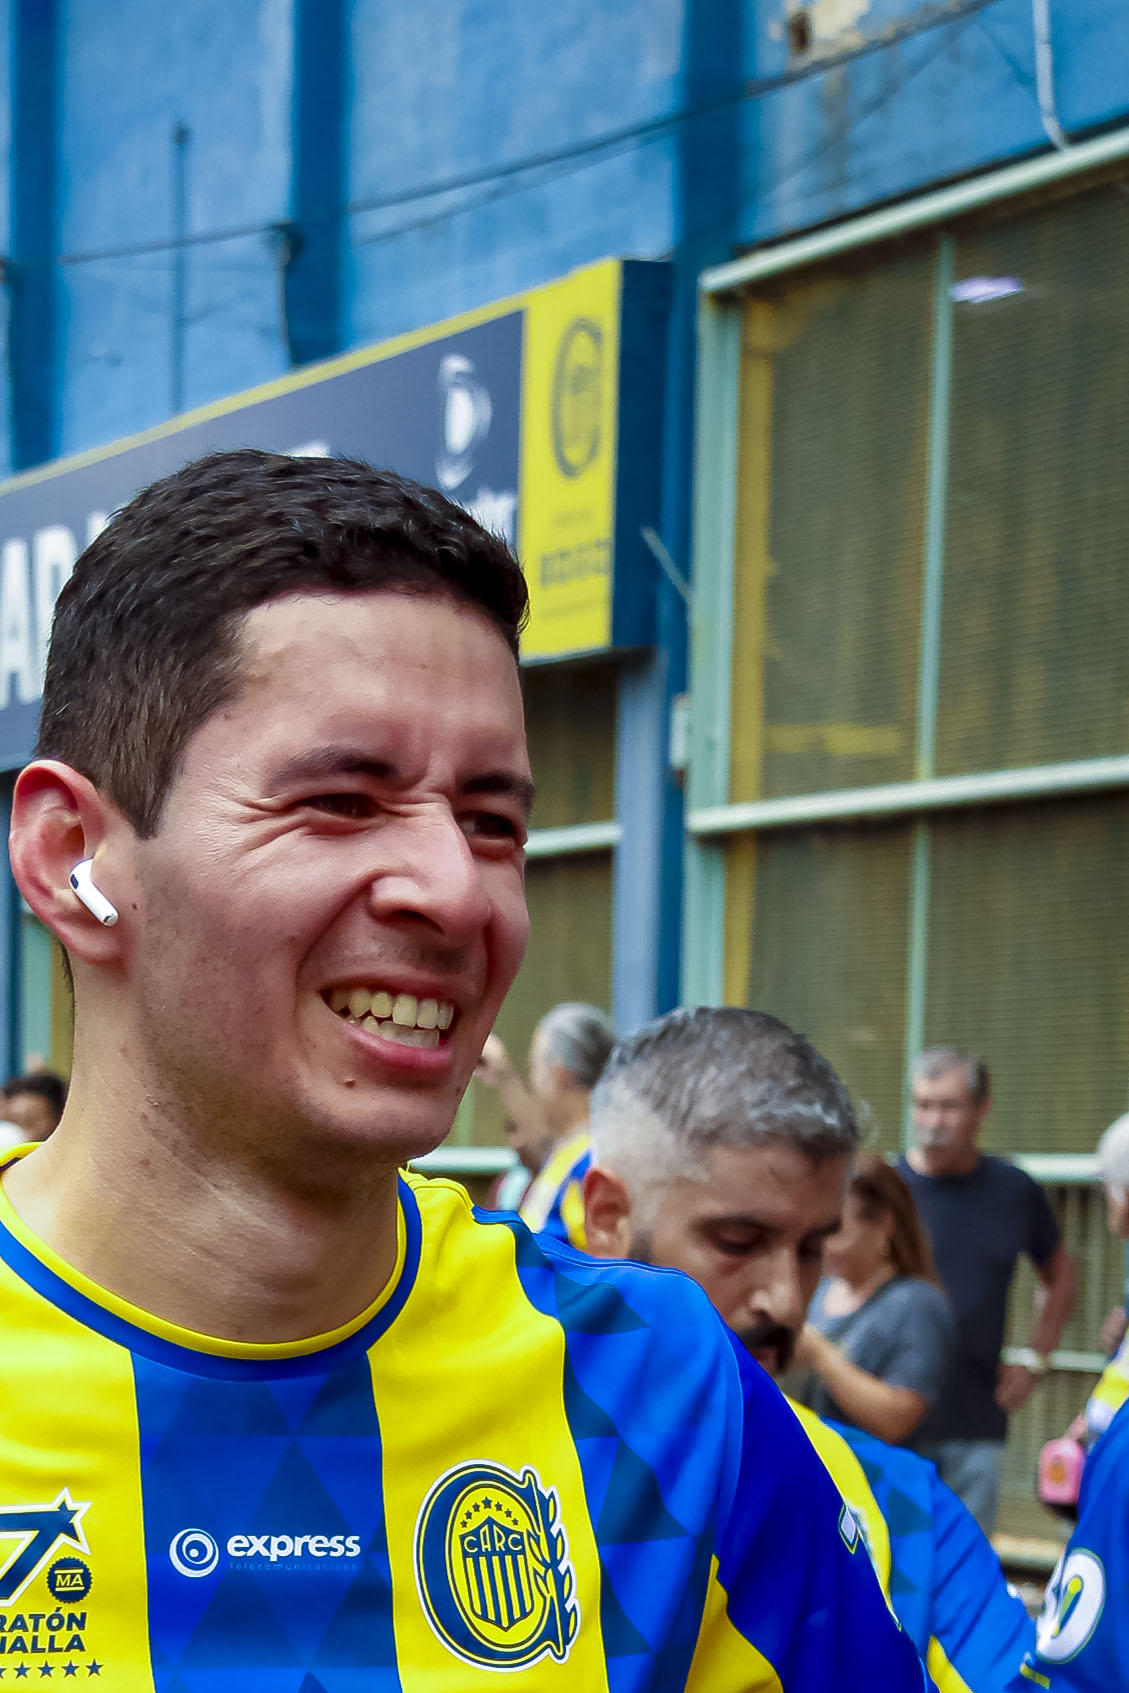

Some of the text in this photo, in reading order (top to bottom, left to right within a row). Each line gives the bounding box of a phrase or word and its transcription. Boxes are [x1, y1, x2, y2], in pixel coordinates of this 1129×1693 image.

[227, 1534, 361, 1562] express
[463, 1523, 523, 1553] CARC
[55, 1574, 84, 1587] MA
